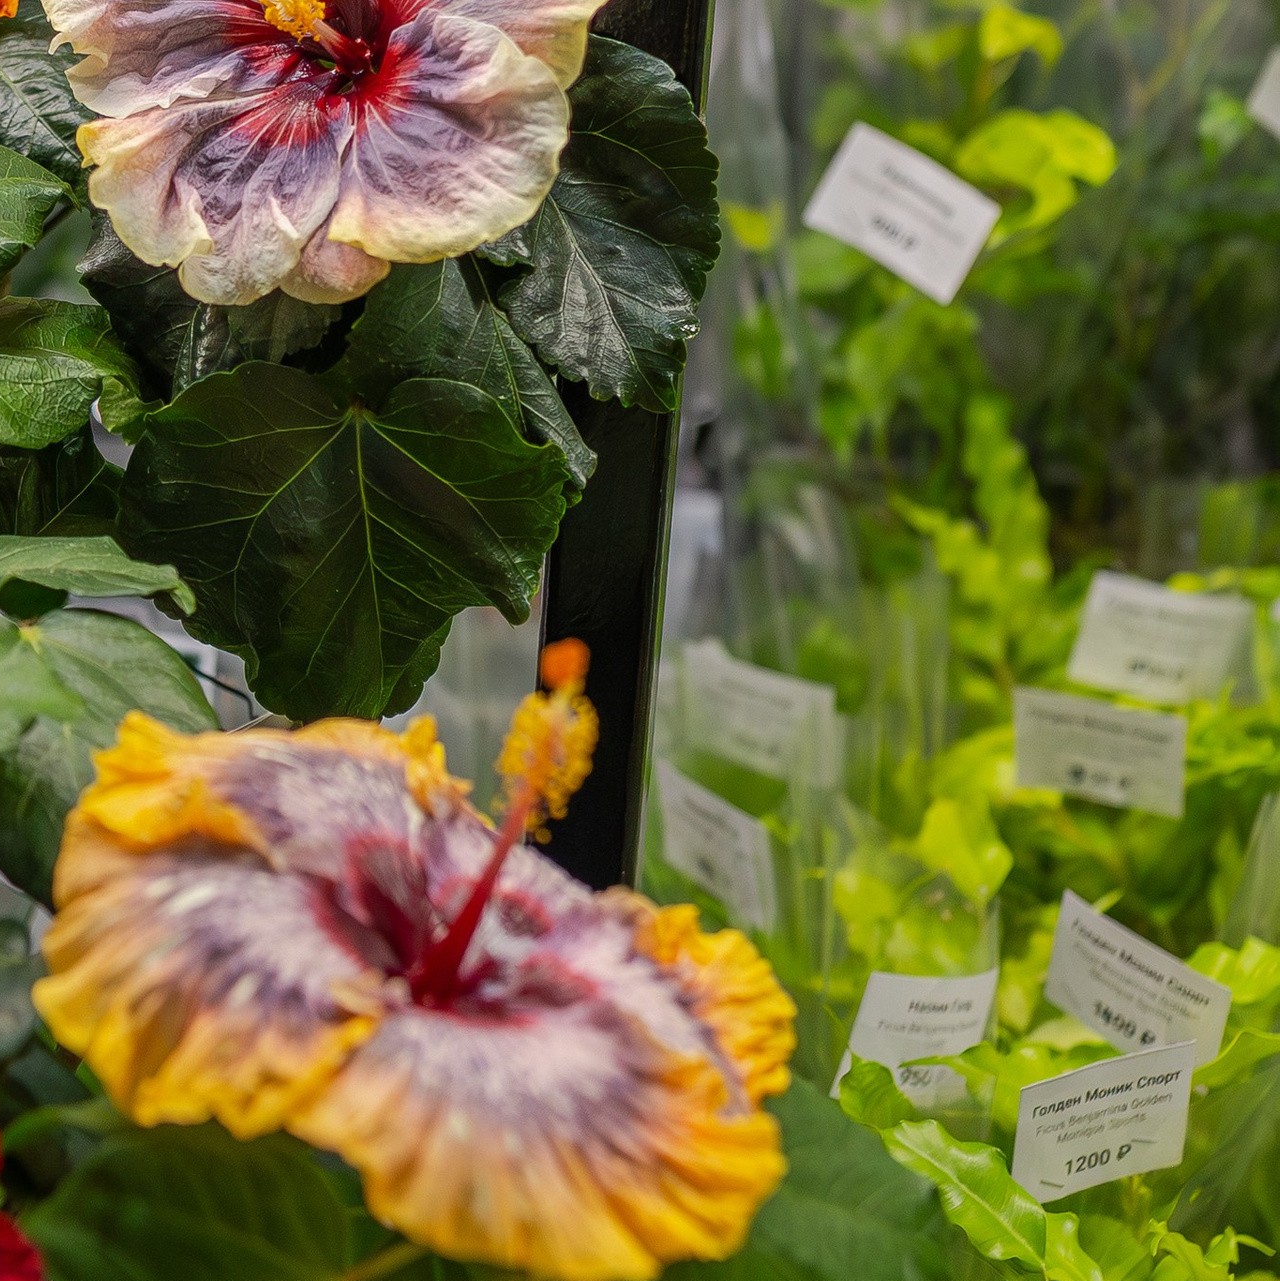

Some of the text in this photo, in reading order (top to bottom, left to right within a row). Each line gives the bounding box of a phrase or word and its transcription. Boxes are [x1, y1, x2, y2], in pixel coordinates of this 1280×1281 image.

[1031, 1069, 1183, 1120] Голден Моник Спорт
[1065, 1147, 1111, 1176] 1200
